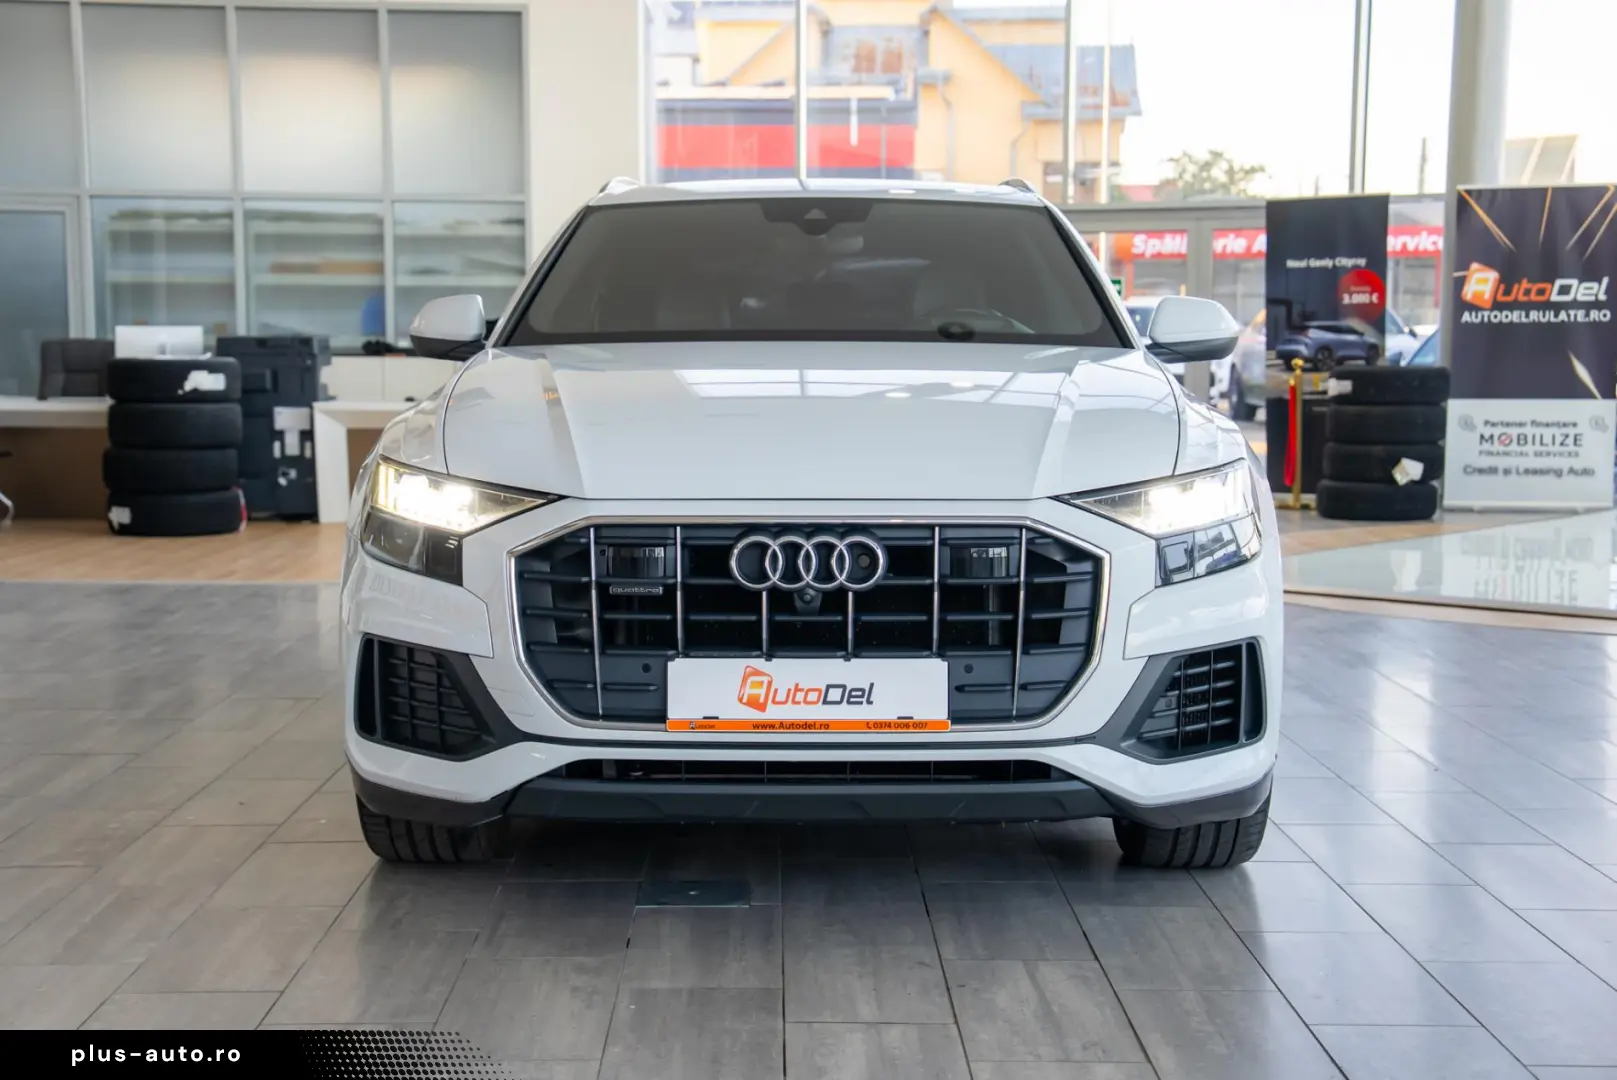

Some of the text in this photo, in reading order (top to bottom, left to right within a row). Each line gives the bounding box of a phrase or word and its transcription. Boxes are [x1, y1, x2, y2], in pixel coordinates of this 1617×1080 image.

[1463, 266, 1610, 304] AutoDel
[1461, 309, 1611, 323] AUTODELRULATE.RO
[1483, 419, 1527, 428] Partener
[1479, 432, 1584, 447] MOBILIZE
[1479, 450, 1580, 458] FINANCIAL SERVICES
[1463, 464, 1498, 475] Credit
[1515, 465, 1563, 478] Leasing
[1567, 466, 1596, 477] Auto
[612, 586, 660, 594] quattro
[740, 671, 874, 707] AutoDel
[752, 721, 830, 730] www.Autodel.ro
[873, 721, 892, 729] 0374
